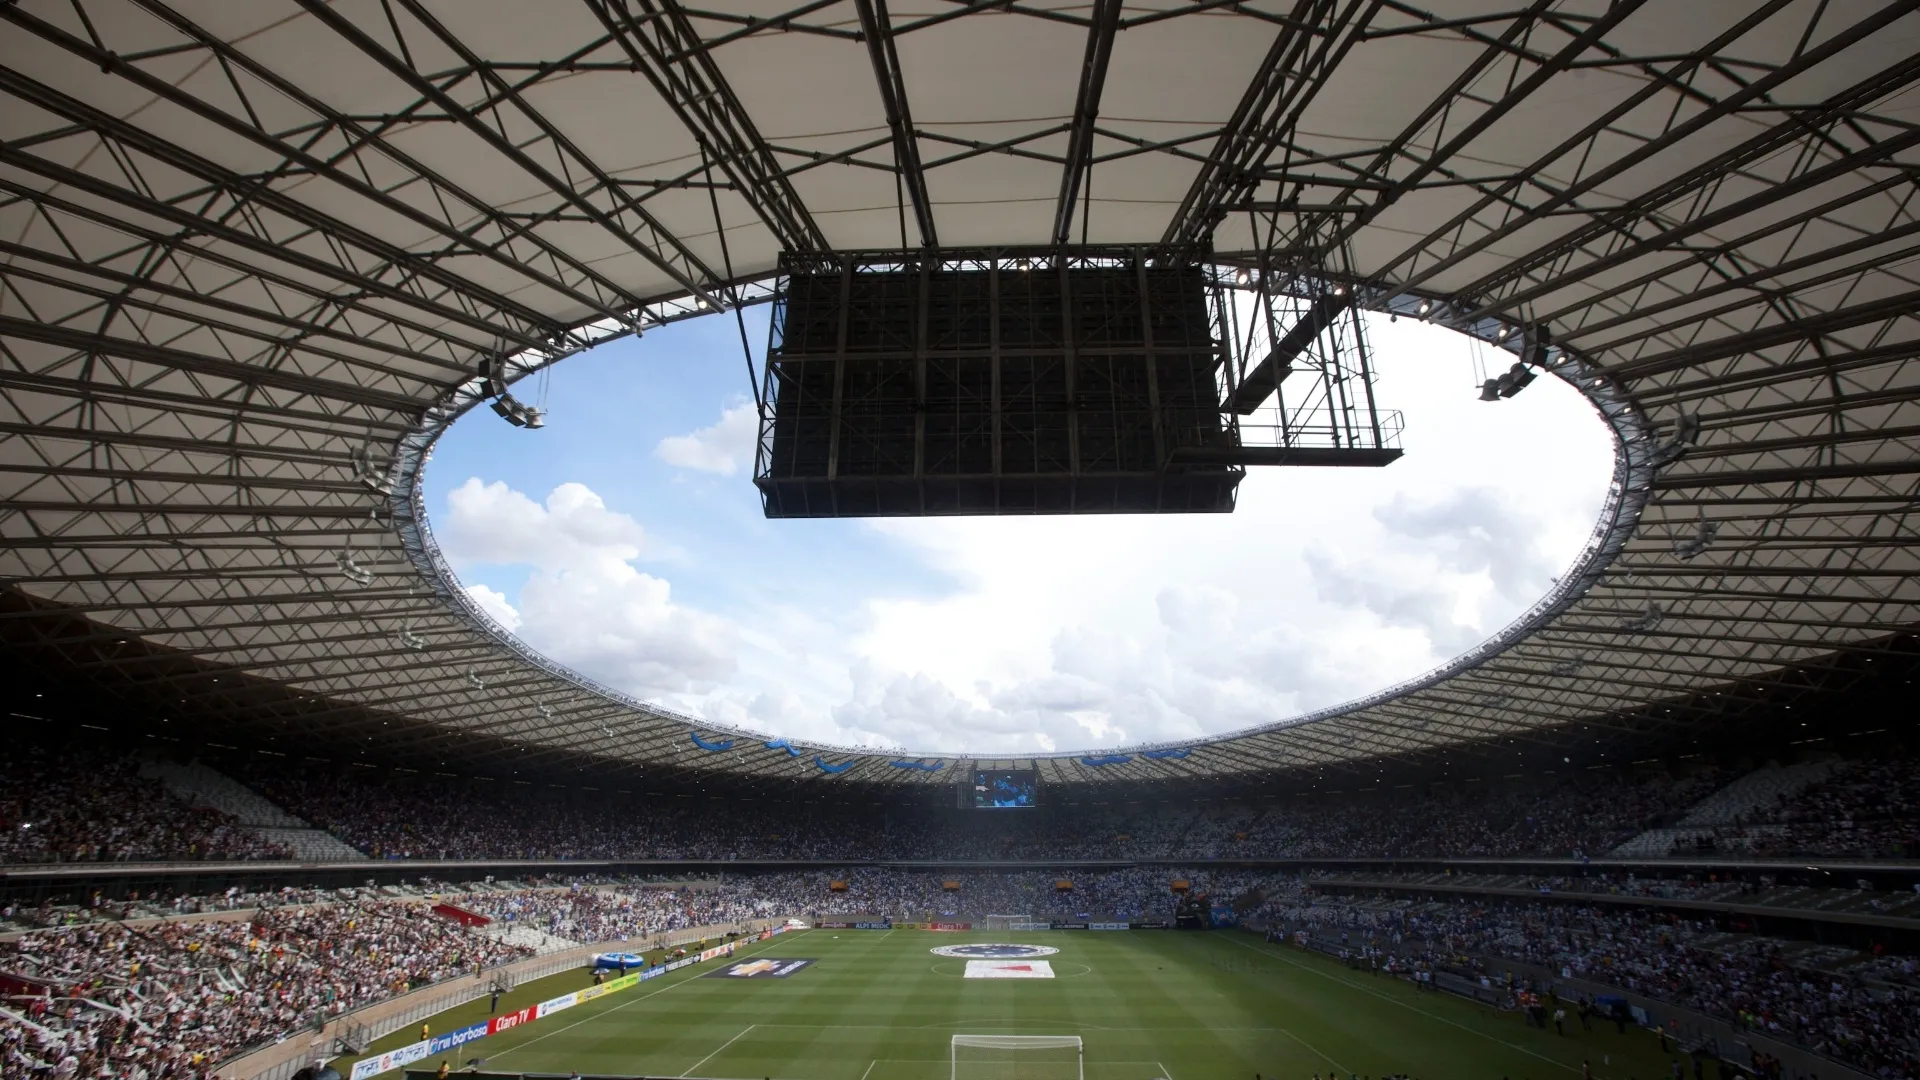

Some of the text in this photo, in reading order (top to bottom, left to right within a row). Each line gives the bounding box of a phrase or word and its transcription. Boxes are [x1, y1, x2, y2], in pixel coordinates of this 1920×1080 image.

[495, 1008, 530, 1032] Claro TV
[437, 1025, 487, 1049] rui barbosa
